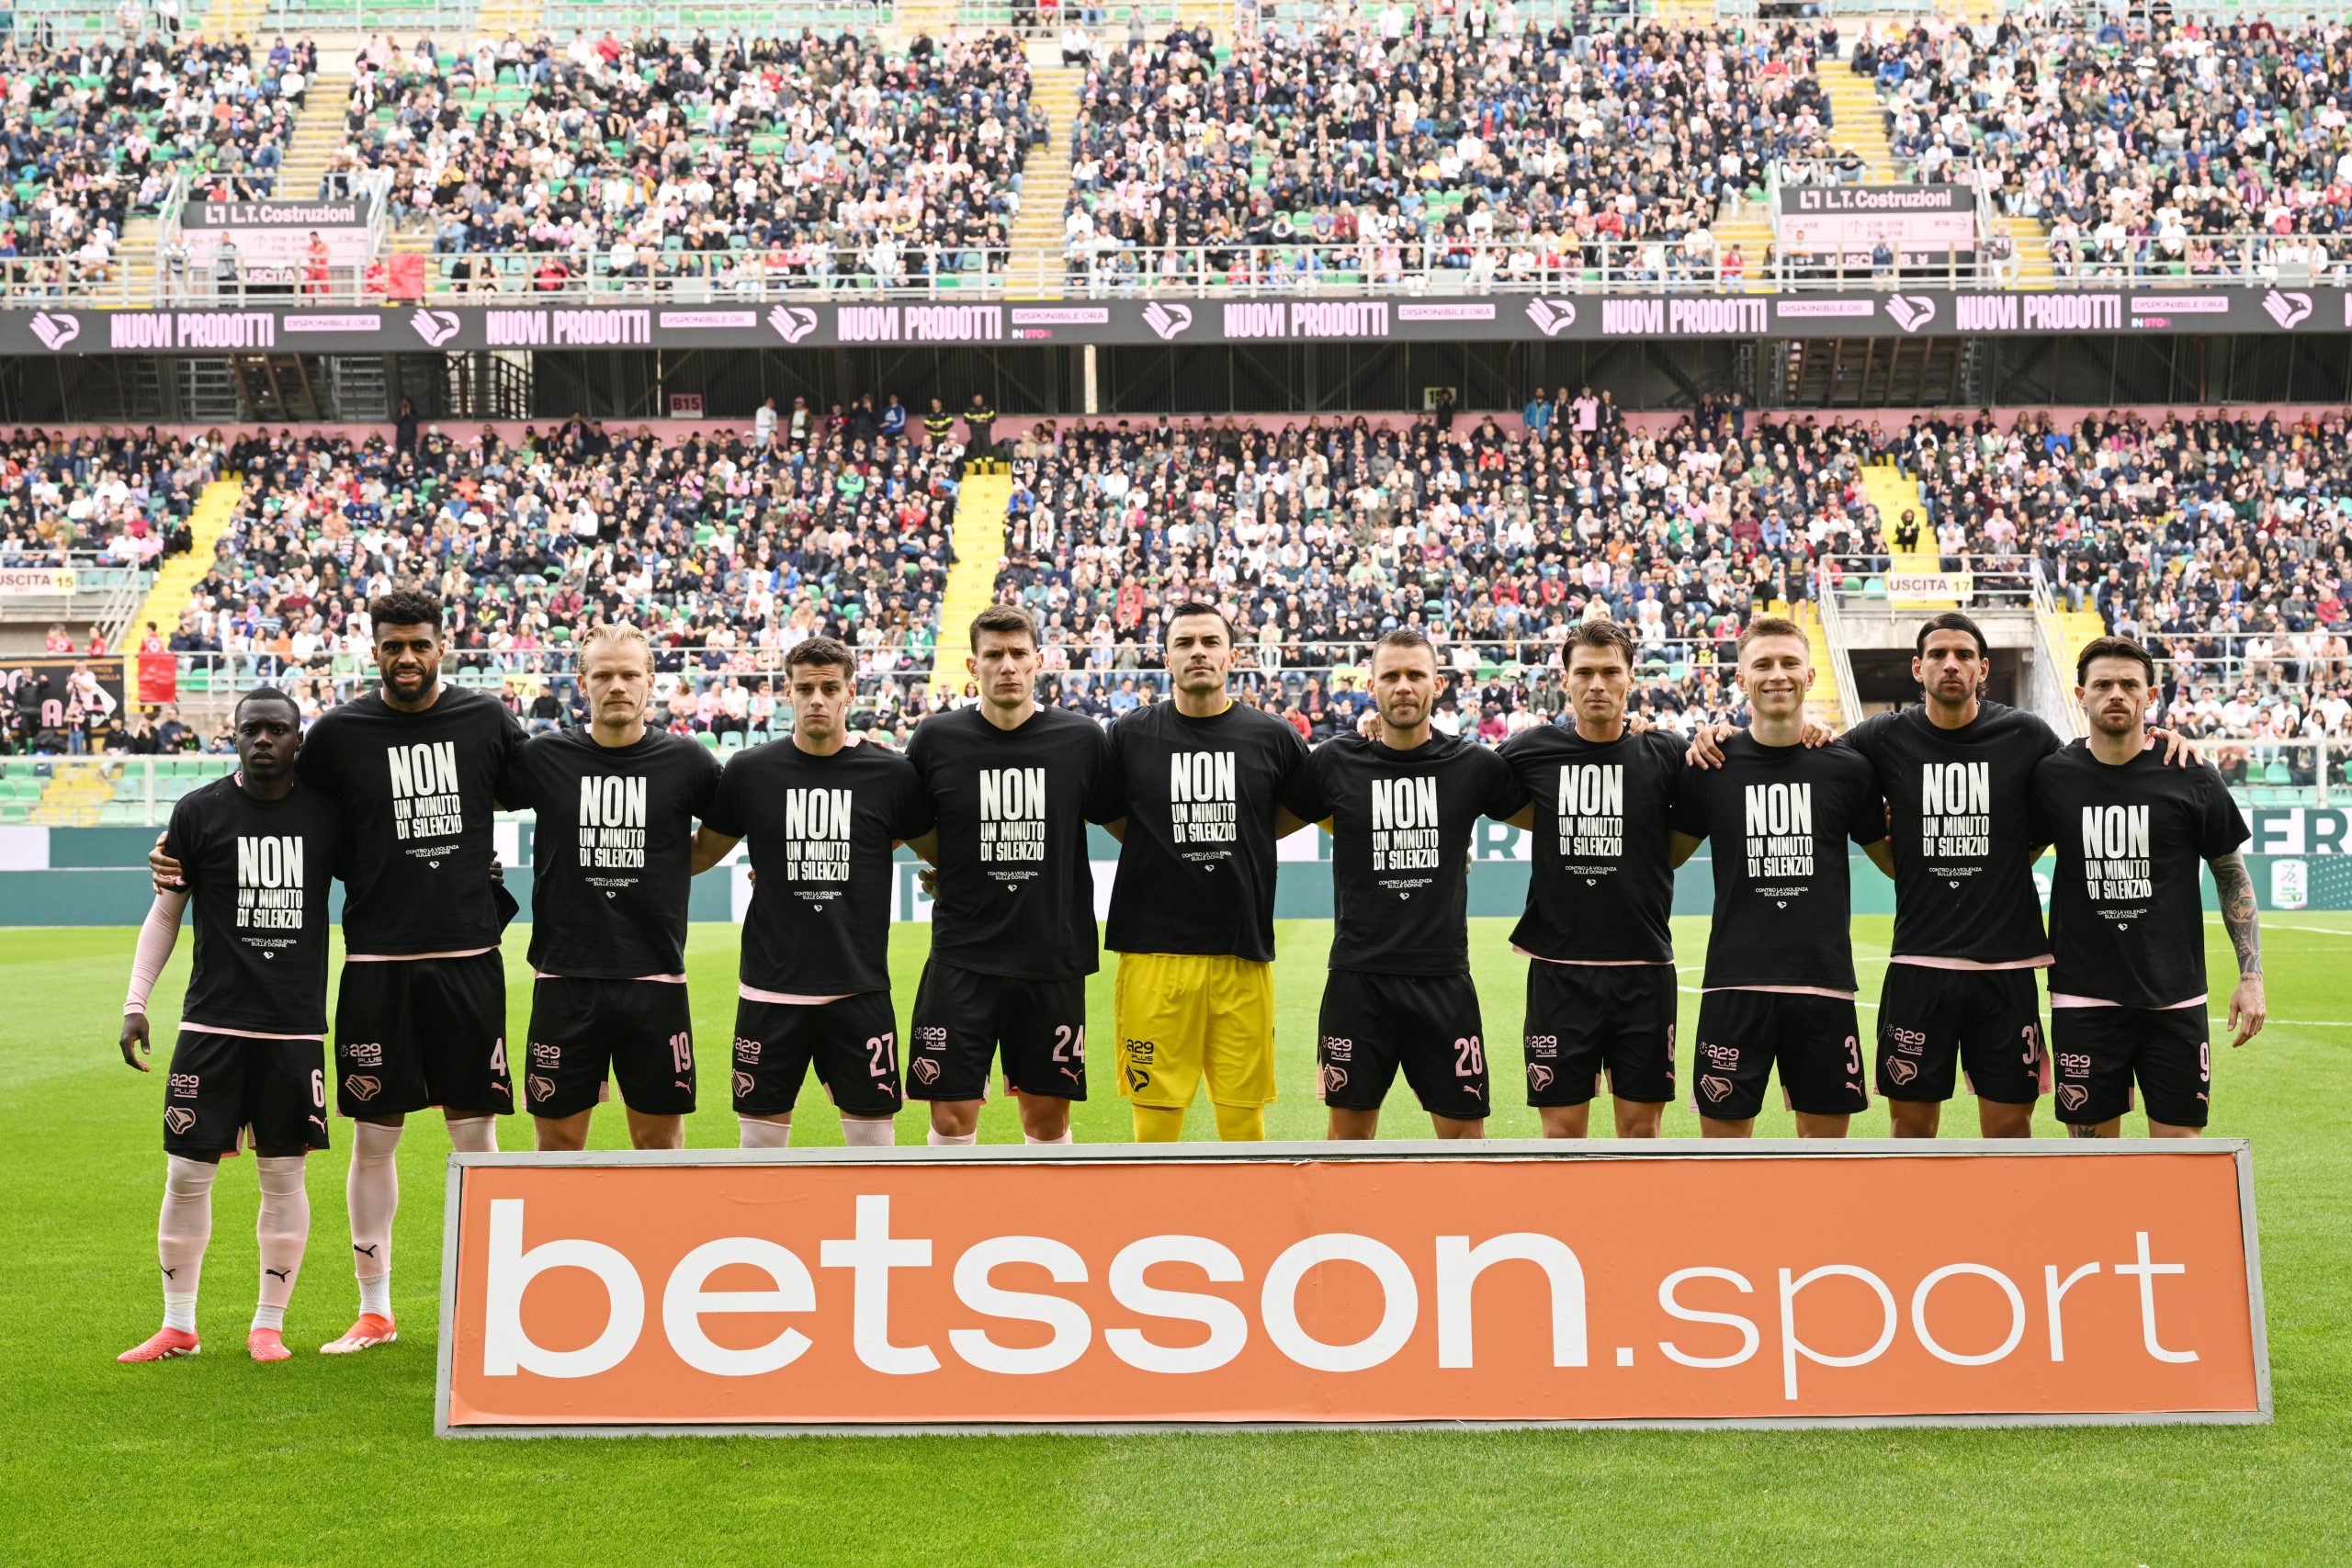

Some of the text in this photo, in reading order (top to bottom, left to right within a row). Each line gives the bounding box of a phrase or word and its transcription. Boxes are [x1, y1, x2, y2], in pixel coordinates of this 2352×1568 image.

[1856, 188, 1951, 208] Costruzioni
[260, 204, 356, 222] Costruzioni
[1402, 308, 1467, 317] DISPONIBILE
[1781, 304, 1844, 313] DISPONIBILE
[1956, 294, 2121, 330] NUOVI PRODOTTI
[2134, 300, 2199, 310] DISPONIBILE
[288, 318, 350, 328] DISPONIBILE
[663, 315, 726, 324] DISPONIBILE
[838, 306, 1002, 341] NUOVI PRODOTTI
[1015, 311, 1080, 321] DISPONIBILE
[1224, 302, 1389, 337] NUOVI PRODOTTI
[1602, 299, 1767, 333] NUOVI PRODOTTI
[2132, 318, 2143, 328] IN
[110, 312, 275, 347] NUOVI PRODOTTI
[486, 310, 650, 344] NUOVI PRODOTTI
[1012, 329, 1024, 339] IN
[673, 397, 700, 411] B15
[56, 577, 74, 588] 15
[1889, 579, 1971, 592] USCITA 17
[388, 741, 458, 798] NON
[1170, 751, 1236, 802] NON
[979, 768, 1046, 820] NON
[1558, 764, 1623, 816] NON
[1923, 761, 1989, 815] NON
[394, 795, 461, 819] UN MINUTO
[580, 775, 647, 827] NON
[1372, 776, 1438, 829] NON
[1746, 783, 1812, 836] NON
[786, 788, 852, 840] NON
[1171, 803, 1237, 824] UN MINUTO
[396, 814, 463, 840] DI SILENZIO
[980, 821, 1045, 841] UN MINUTO
[1173, 822, 1237, 843] DI SILENZIO
[1559, 817, 1623, 837] UN MINUTO
[1923, 815, 1989, 837] UN MINUTO
[2082, 805, 2150, 859] NON
[580, 828, 645, 849] UN MINUTO
[1373, 829, 1439, 851] UN MINUTO
[1560, 836, 1623, 856] DI SILENZIO
[1747, 836, 1814, 858] UN MINUTO
[1923, 836, 1989, 857] DI SILENZIO
[238, 836, 303, 888] NON
[580, 848, 644, 868] DI SILENZIO
[786, 841, 850, 862] UN MINUTO
[980, 841, 1045, 862] DI SILENZIO
[1374, 849, 1439, 871] DI SILENZIO
[787, 861, 850, 882] DI SILENZIO
[1747, 856, 1814, 877] DI SILENZIO
[2085, 859, 2150, 880] UN MINUTO
[238, 888, 303, 909] UN MINUTO
[2086, 878, 2153, 900] DI SILENZIO
[237, 908, 303, 929] DI SILENZIO
[669, 1032, 692, 1073] 19
[865, 1032, 895, 1077] 27
[1052, 1024, 1084, 1064] 24
[1897, 1043, 1923, 1053] PLUS
[490, 1037, 506, 1077] 4
[536, 1057, 560, 1066] PLUS
[738, 1052, 759, 1061] PLUS
[1131, 1054, 1153, 1062] PLUS
[1453, 1035, 1483, 1077] 28
[1712, 1059, 1737, 1068] PLUS
[1844, 1035, 1860, 1075] 3
[2199, 1042, 2211, 1082] 9
[311, 1068, 325, 1108] 6
[483, 1194, 2200, 1402] betsson.sport
